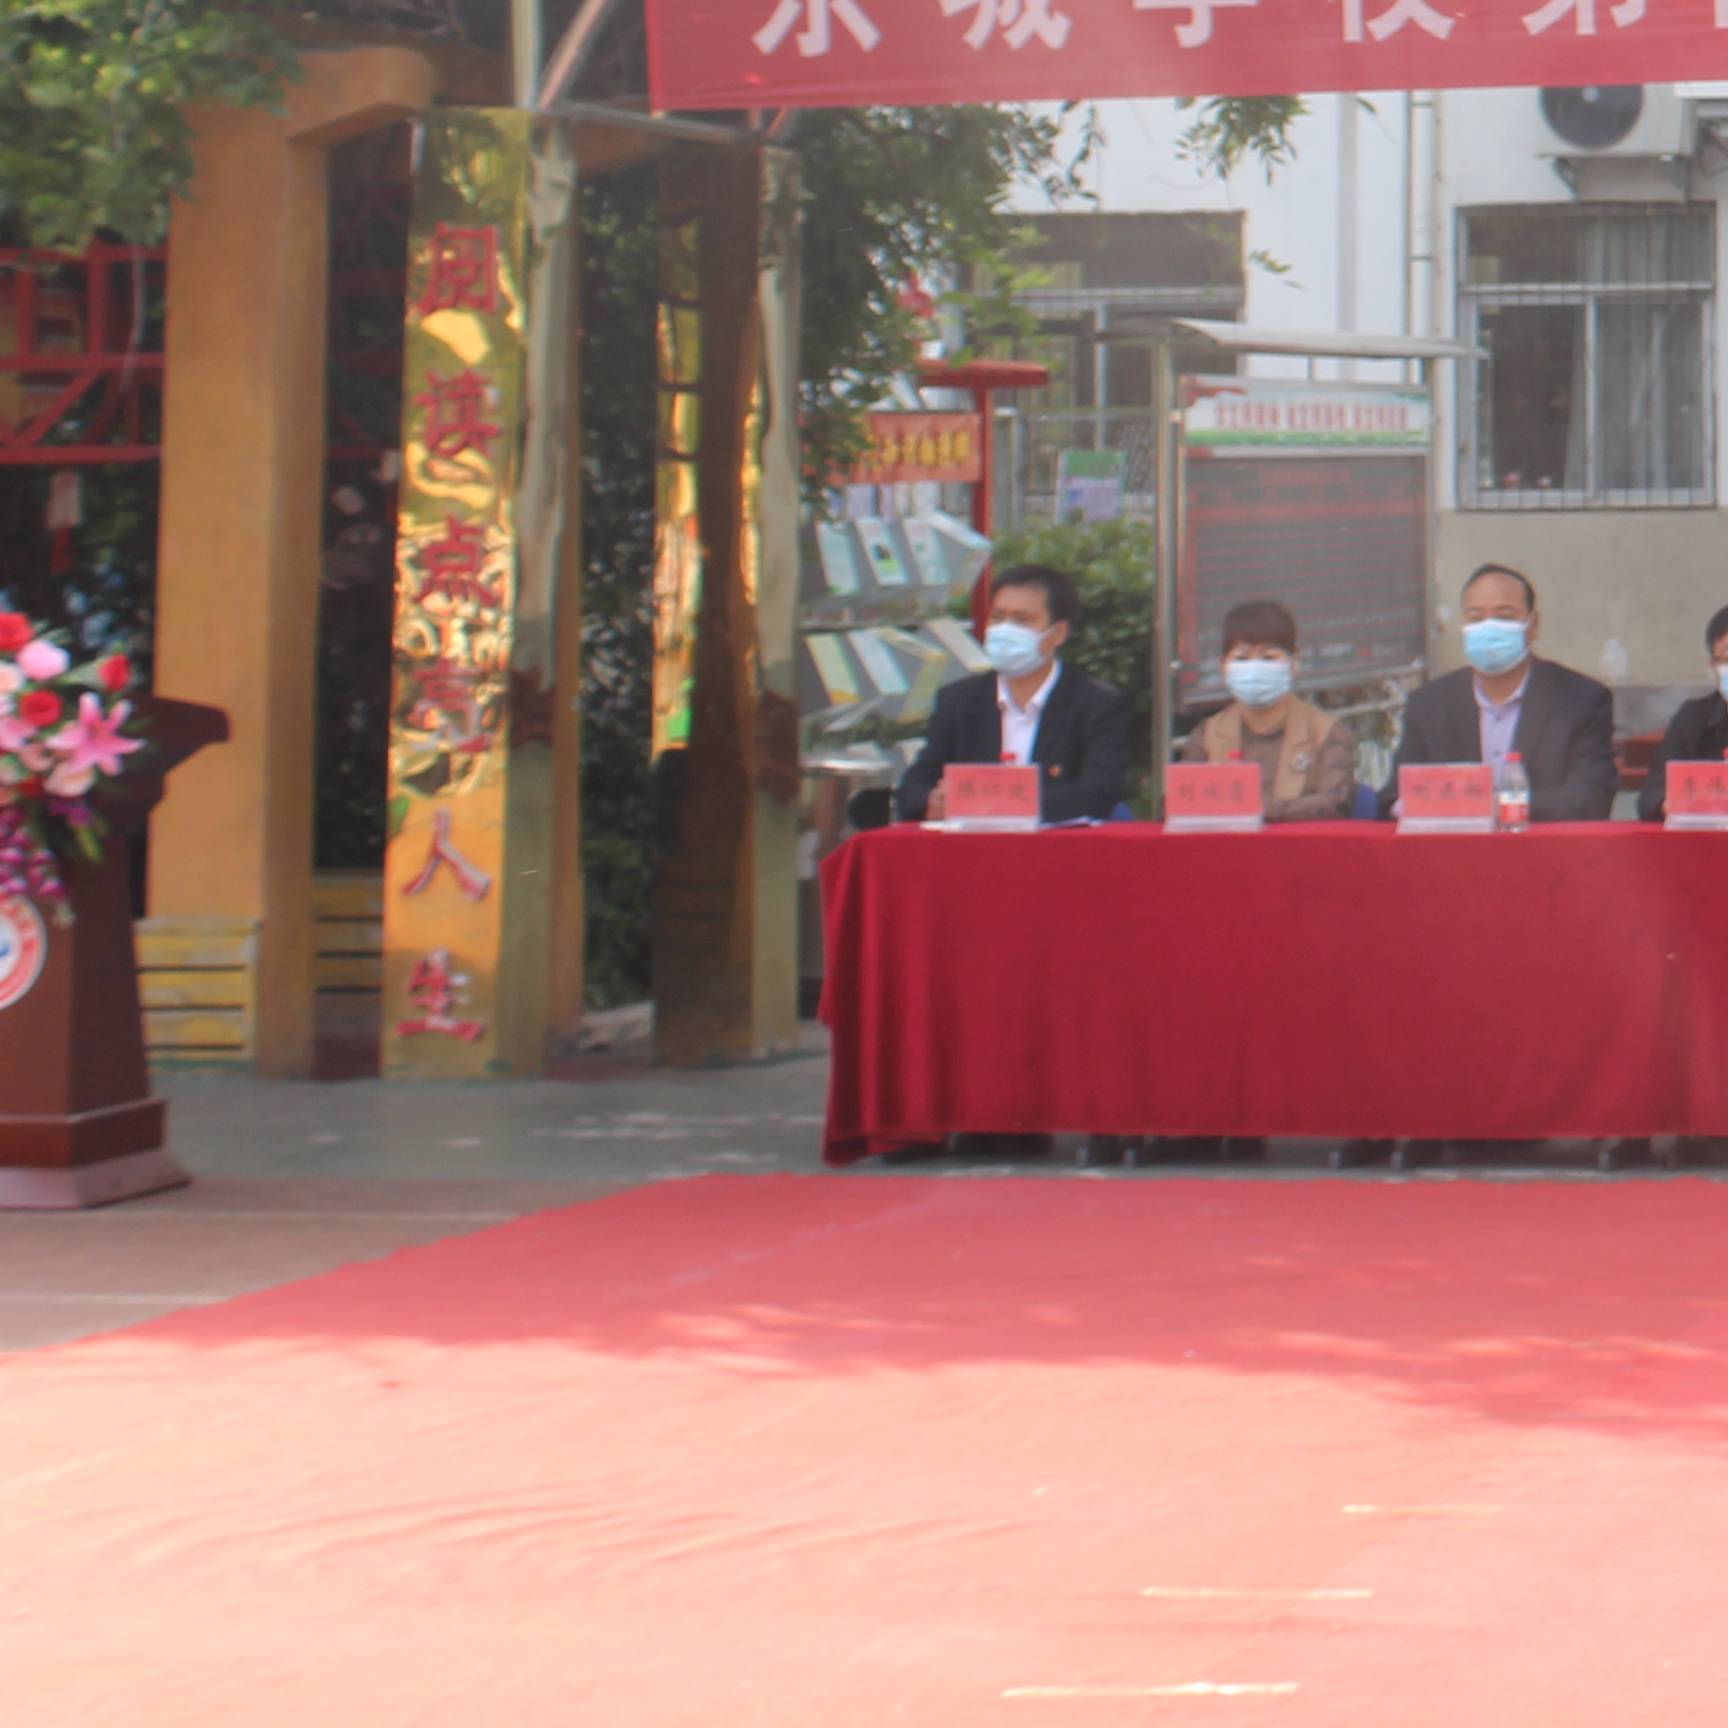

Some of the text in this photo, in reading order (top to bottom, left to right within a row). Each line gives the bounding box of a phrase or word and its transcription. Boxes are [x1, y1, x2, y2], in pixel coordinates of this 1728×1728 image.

[396, 221, 502, 1042] 阅读点亮人生
